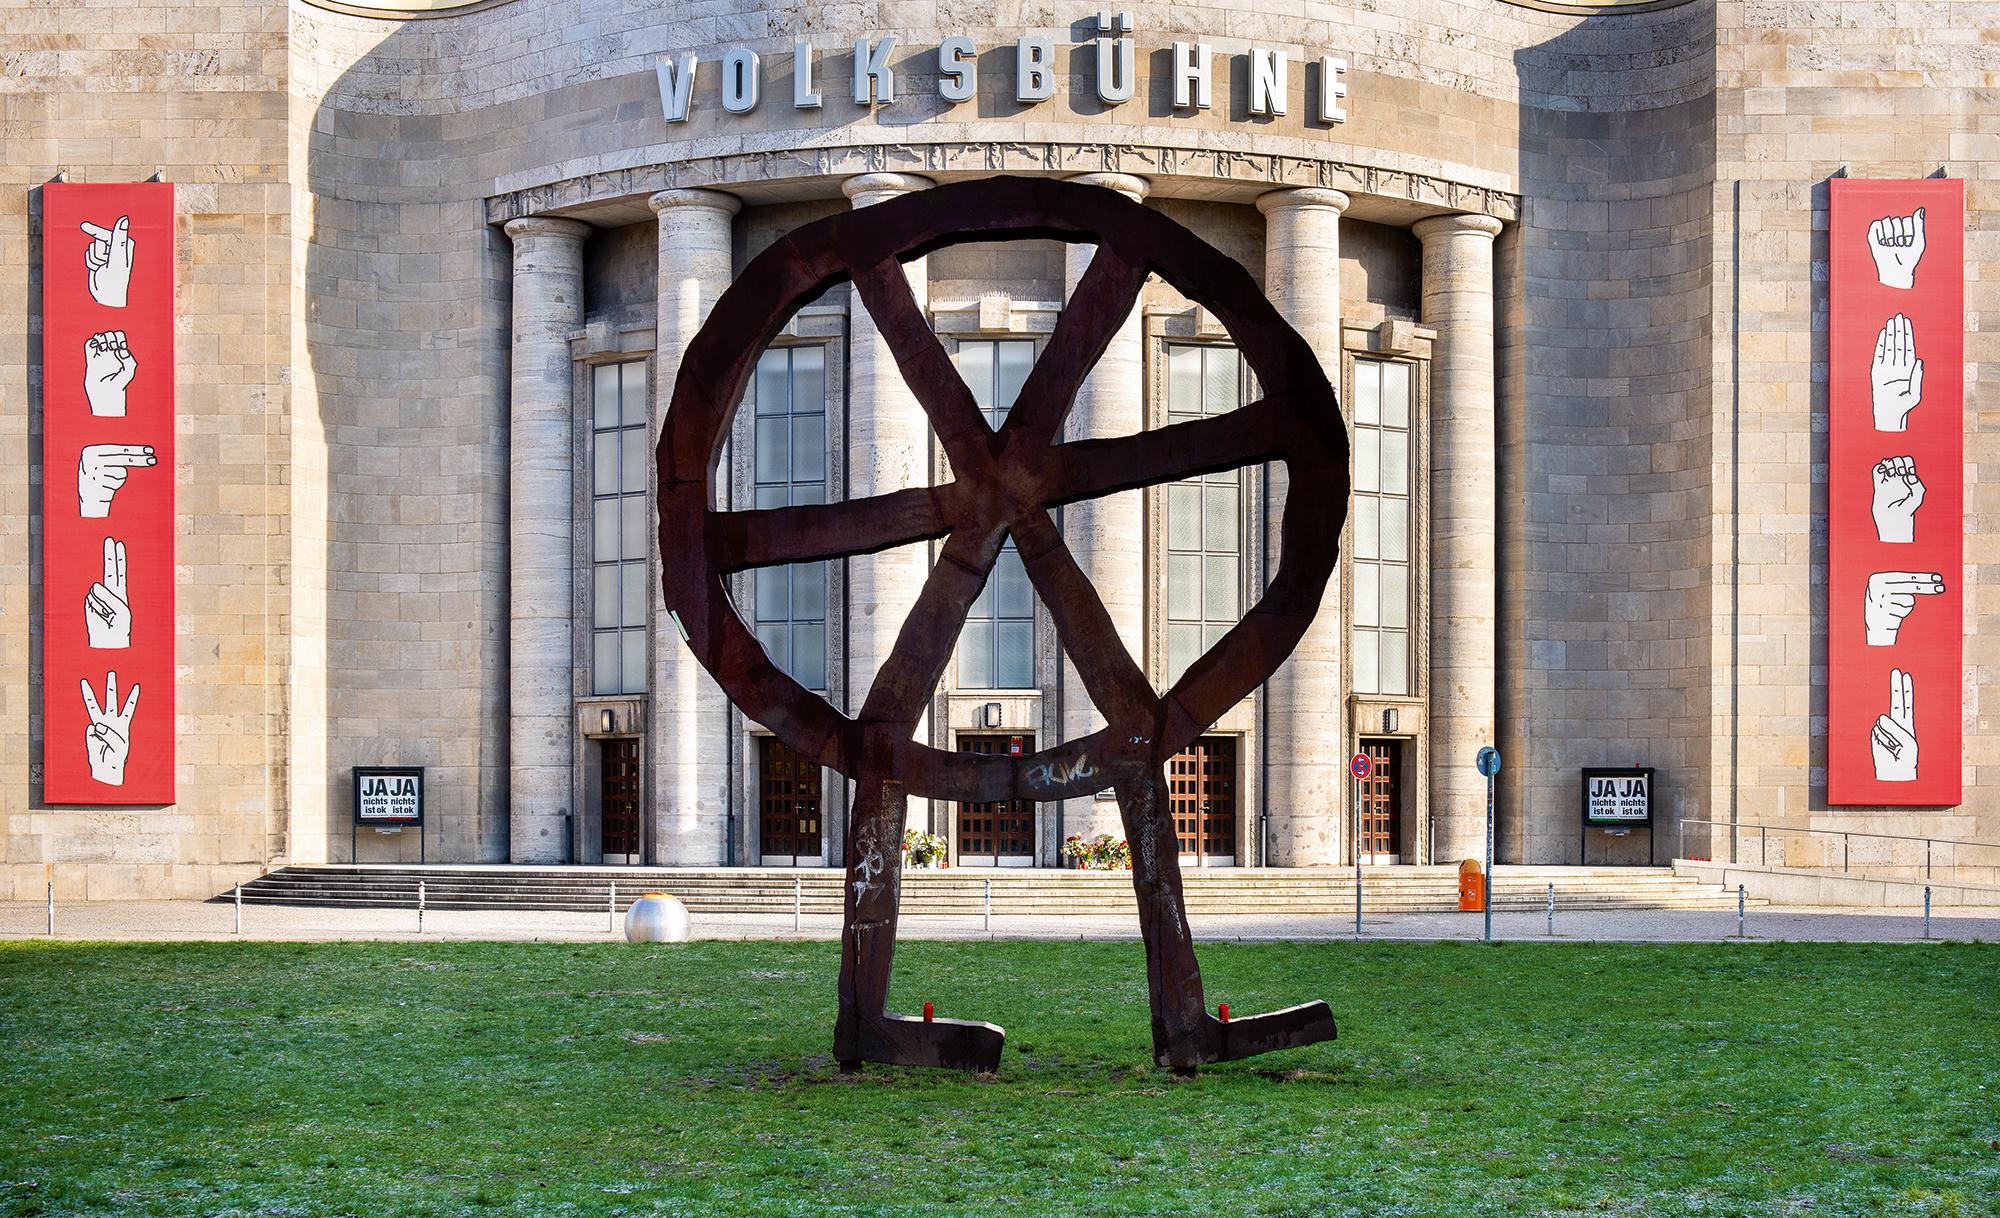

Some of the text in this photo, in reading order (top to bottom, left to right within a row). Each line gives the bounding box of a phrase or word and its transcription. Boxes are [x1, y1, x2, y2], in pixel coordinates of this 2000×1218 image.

[655, 11, 1348, 124] VOLKSBÜHNE
[365, 806, 386, 814] ist ok
[393, 806, 414, 814] ist ok
[1593, 807, 1615, 815] ist ok
[1622, 807, 1644, 815] ist ok
